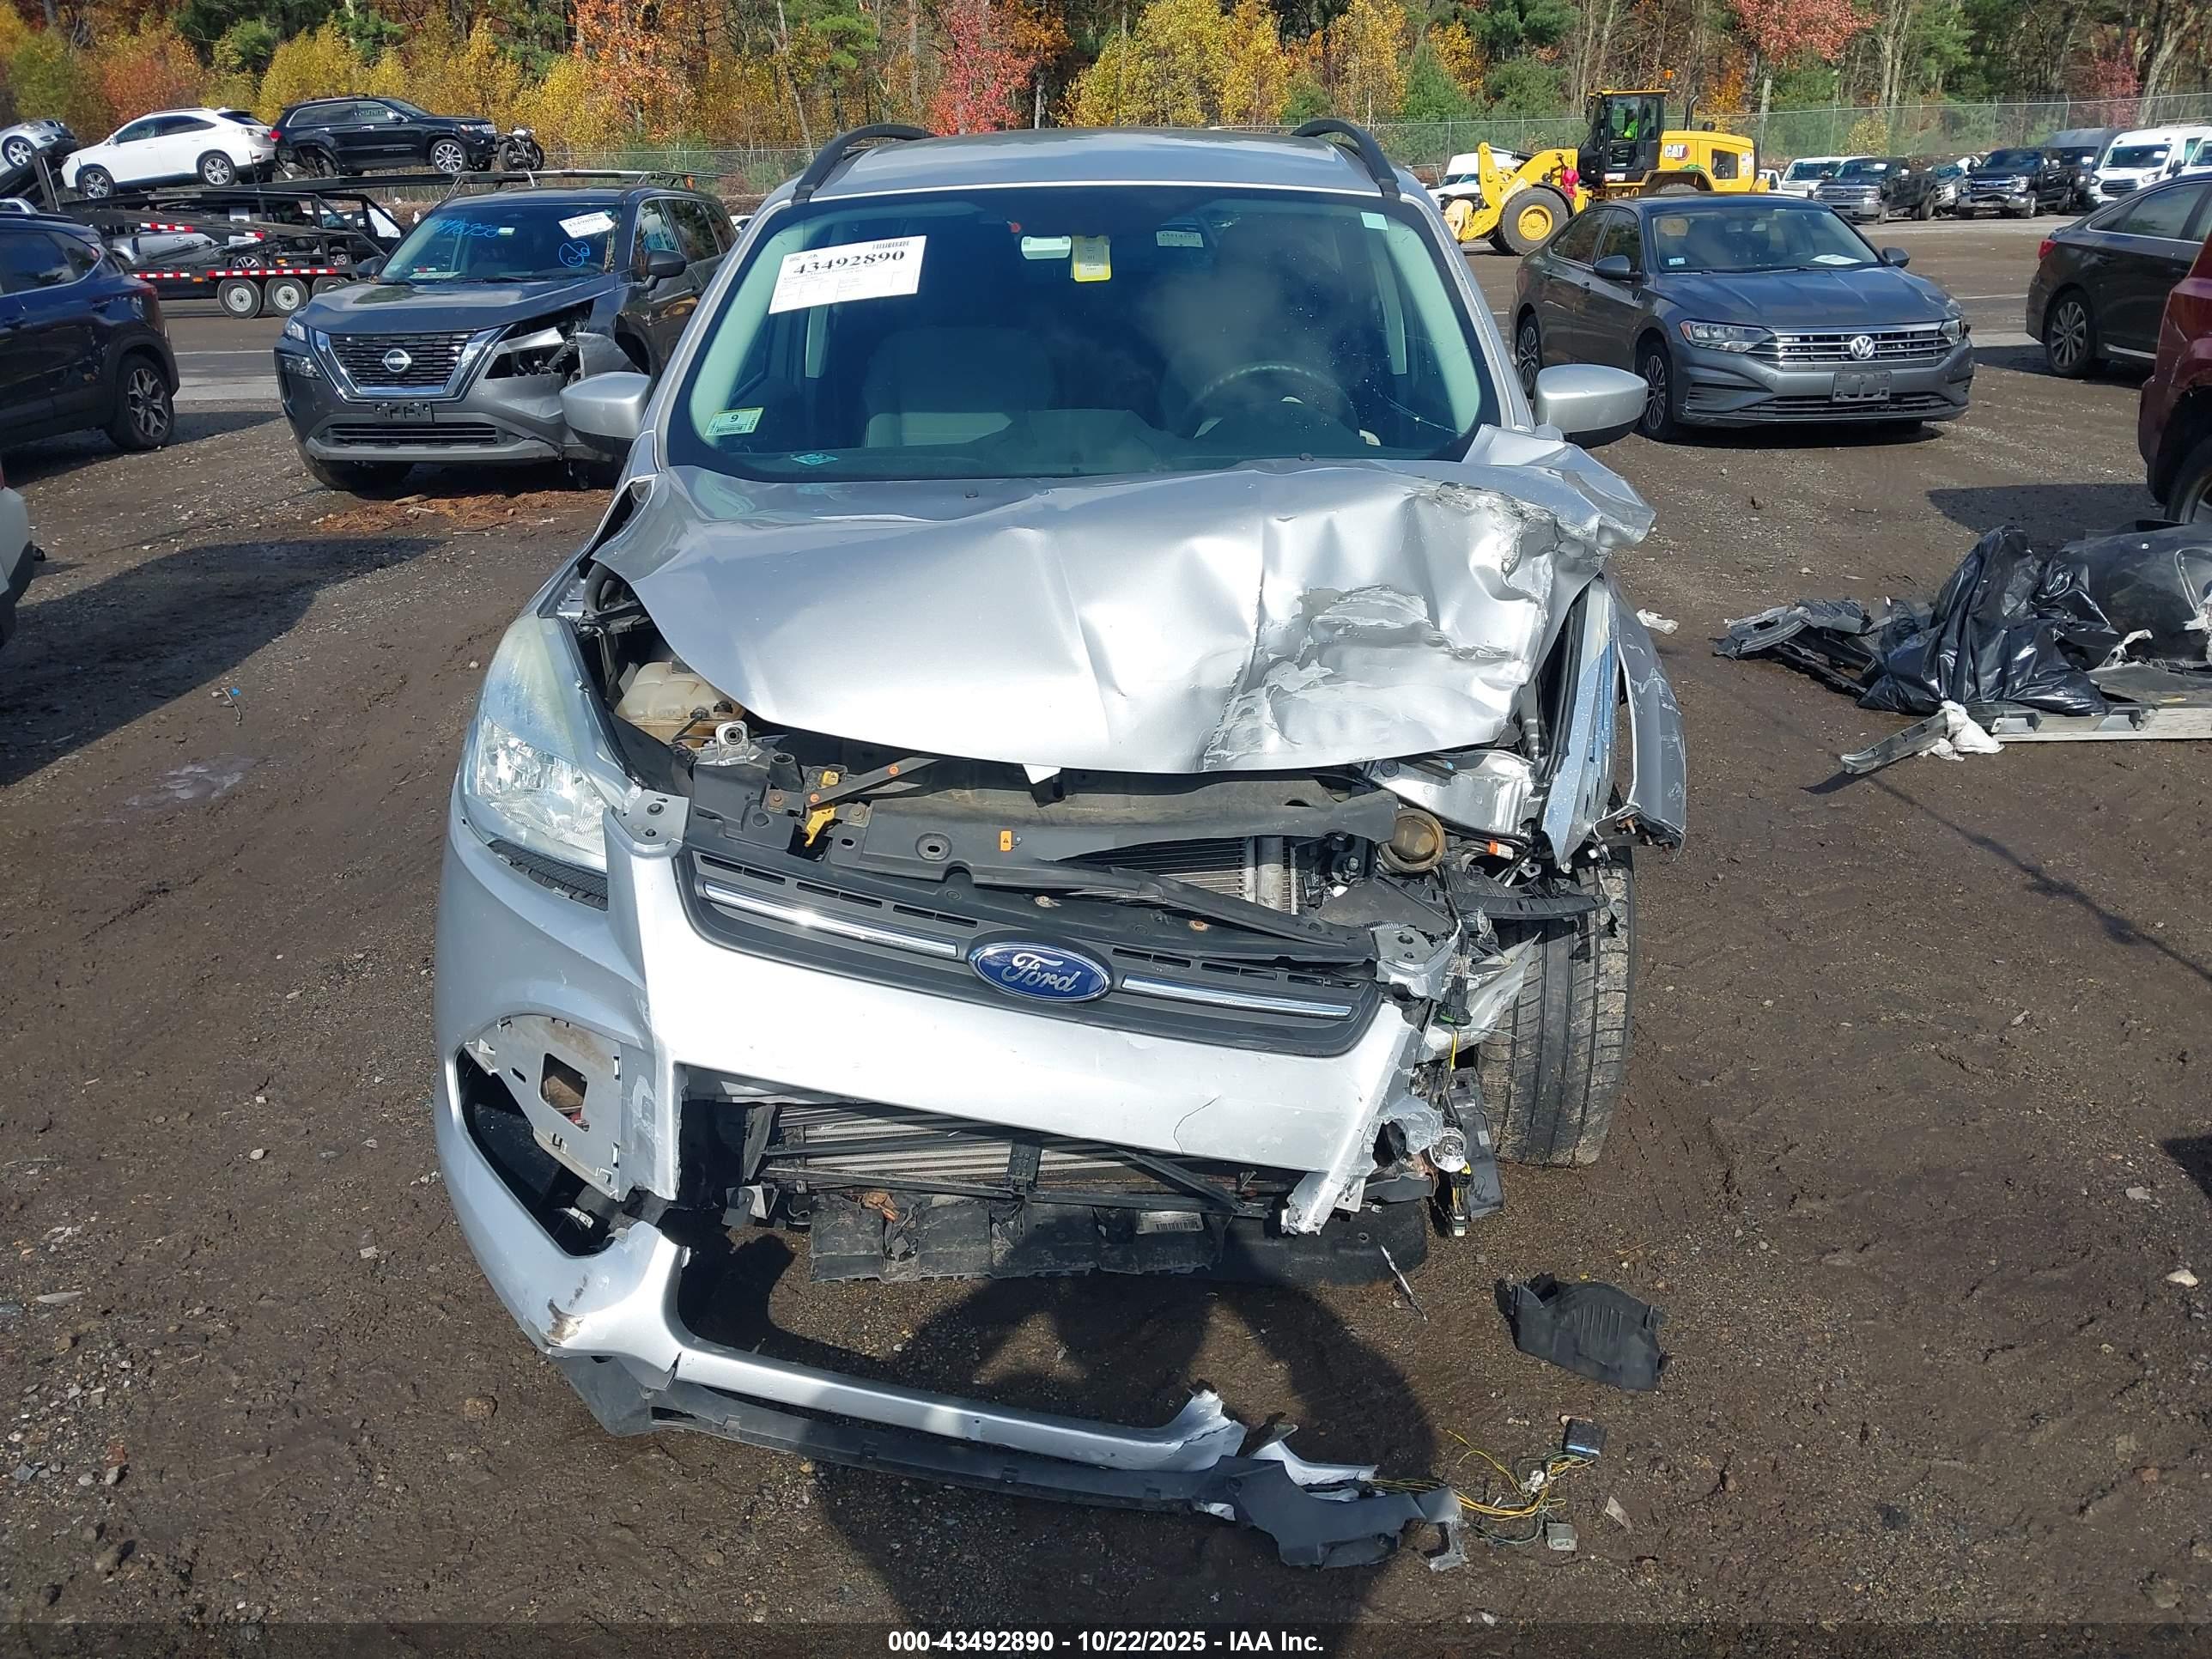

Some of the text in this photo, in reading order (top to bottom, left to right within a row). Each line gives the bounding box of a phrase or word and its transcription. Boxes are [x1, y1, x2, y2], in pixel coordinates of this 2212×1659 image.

[1664, 144, 1686, 158] CAT
[793, 250, 905, 275] 43492890
[729, 414, 739, 423] 9
[1000, 952, 1082, 993] Ford
